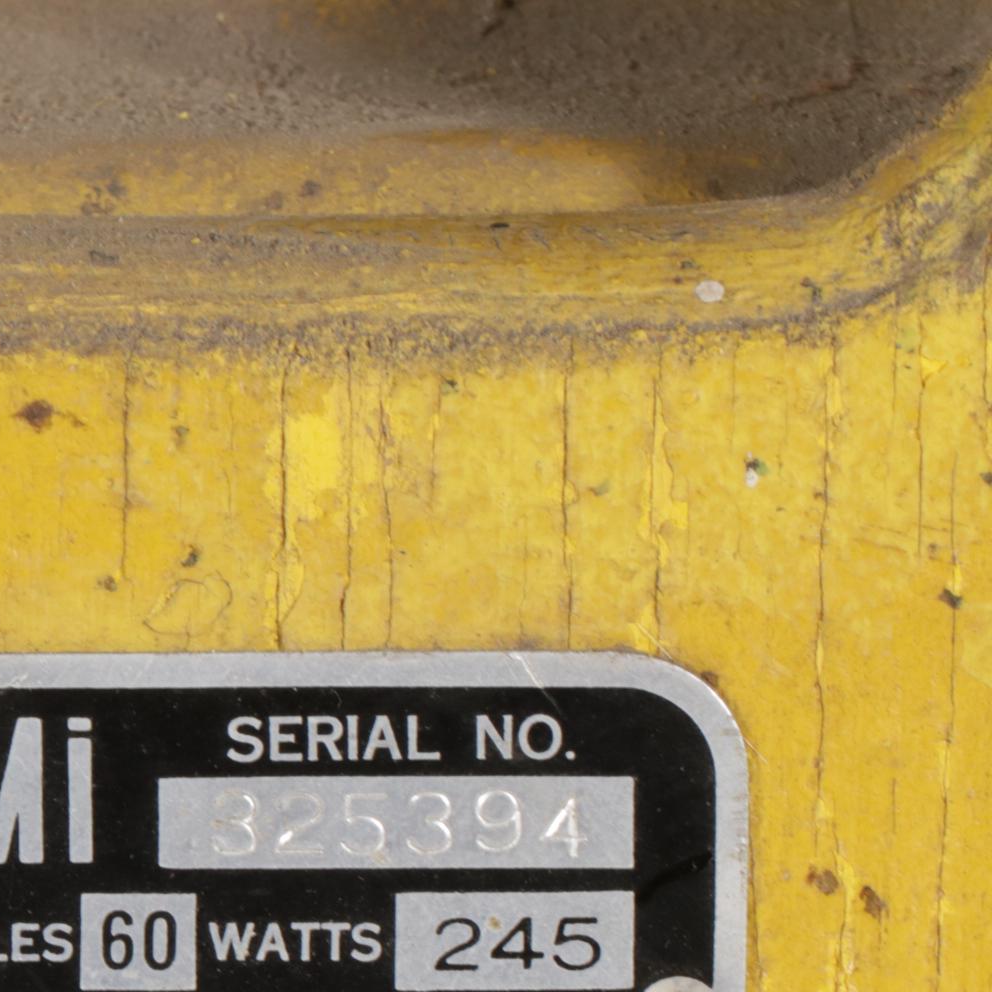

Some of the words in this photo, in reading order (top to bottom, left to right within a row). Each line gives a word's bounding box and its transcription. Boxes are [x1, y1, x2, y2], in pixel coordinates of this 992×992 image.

[226, 713, 440, 763] SERIAL
[475, 713, 577, 761] NO.
[210, 788, 588, 859] 325394
[101, 910, 177, 971] 60
[208, 921, 383, 963] WATTS
[434, 916, 603, 971] 245
